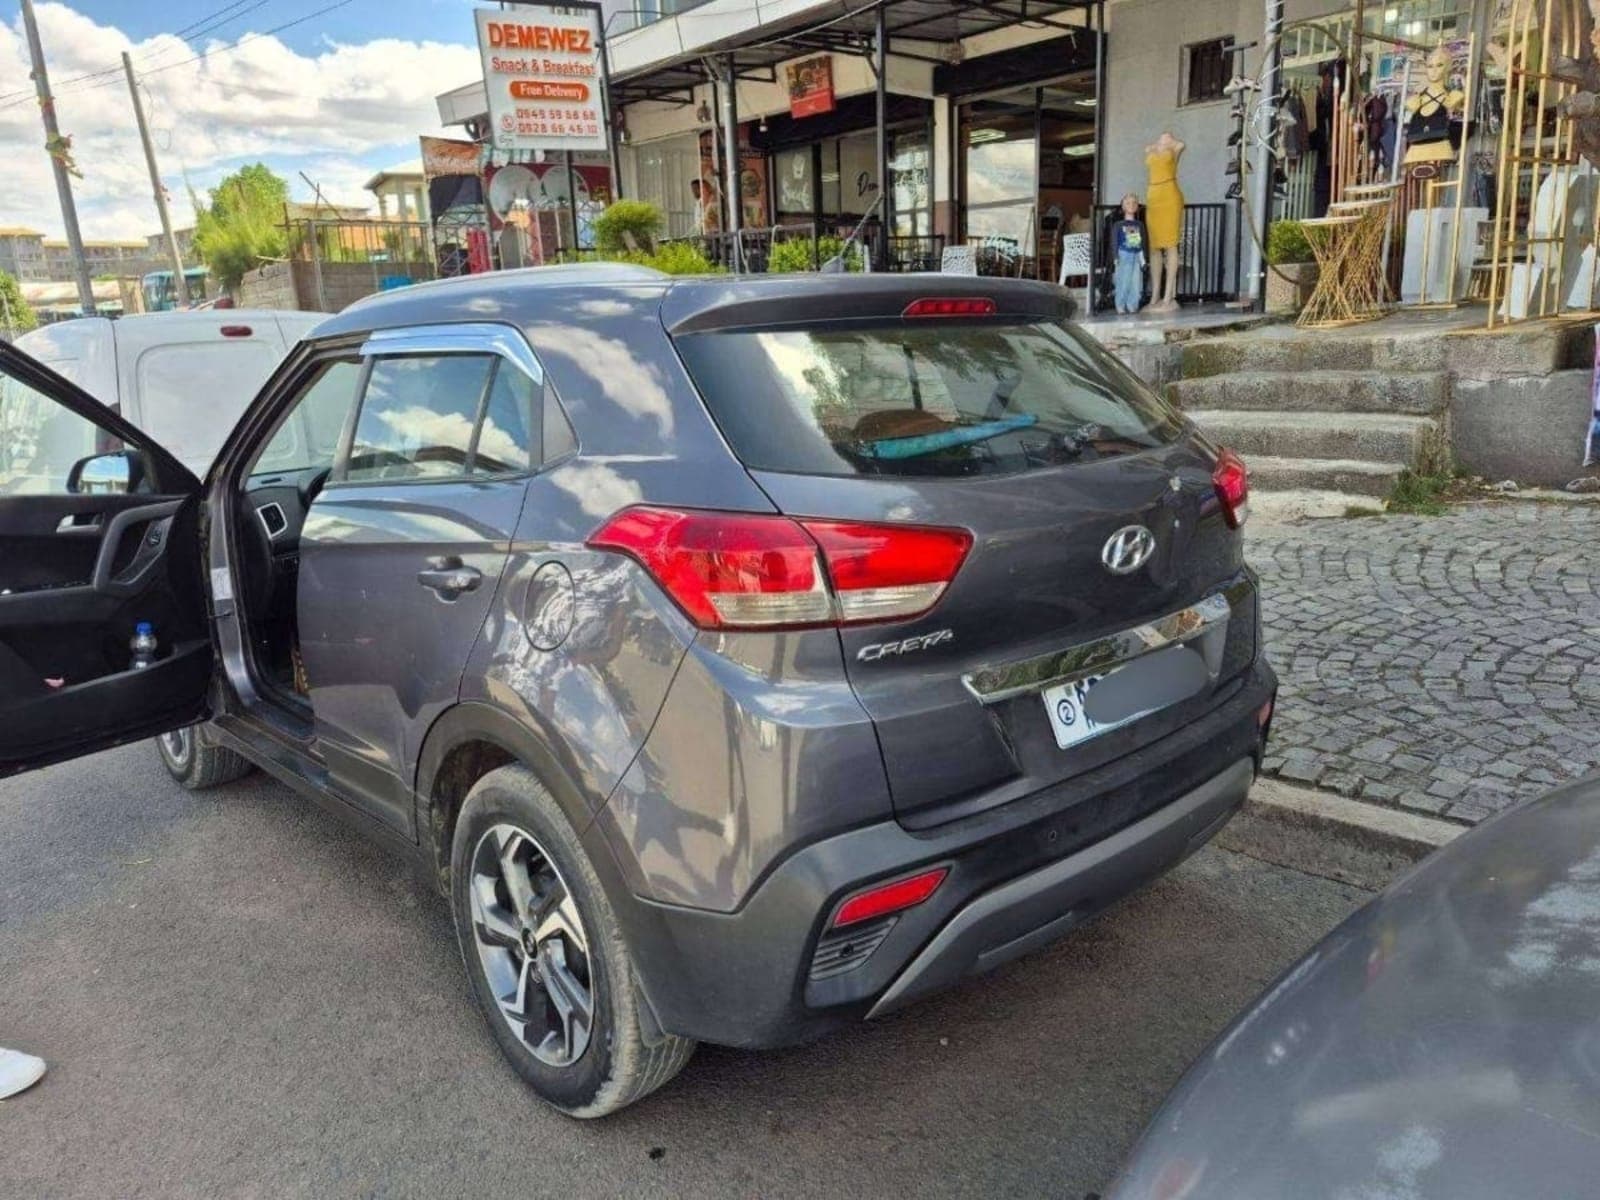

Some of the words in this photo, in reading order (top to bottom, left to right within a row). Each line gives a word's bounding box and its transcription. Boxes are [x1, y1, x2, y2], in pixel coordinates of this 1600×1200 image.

[487, 22, 592, 54] DEMEWEZ
[491, 57, 527, 72] Snack
[531, 58, 539, 72] &
[543, 59, 595, 76] Breakfast
[520, 83, 543, 95] Free
[544, 84, 582, 101] Delivery
[857, 628, 954, 661] CRETA
